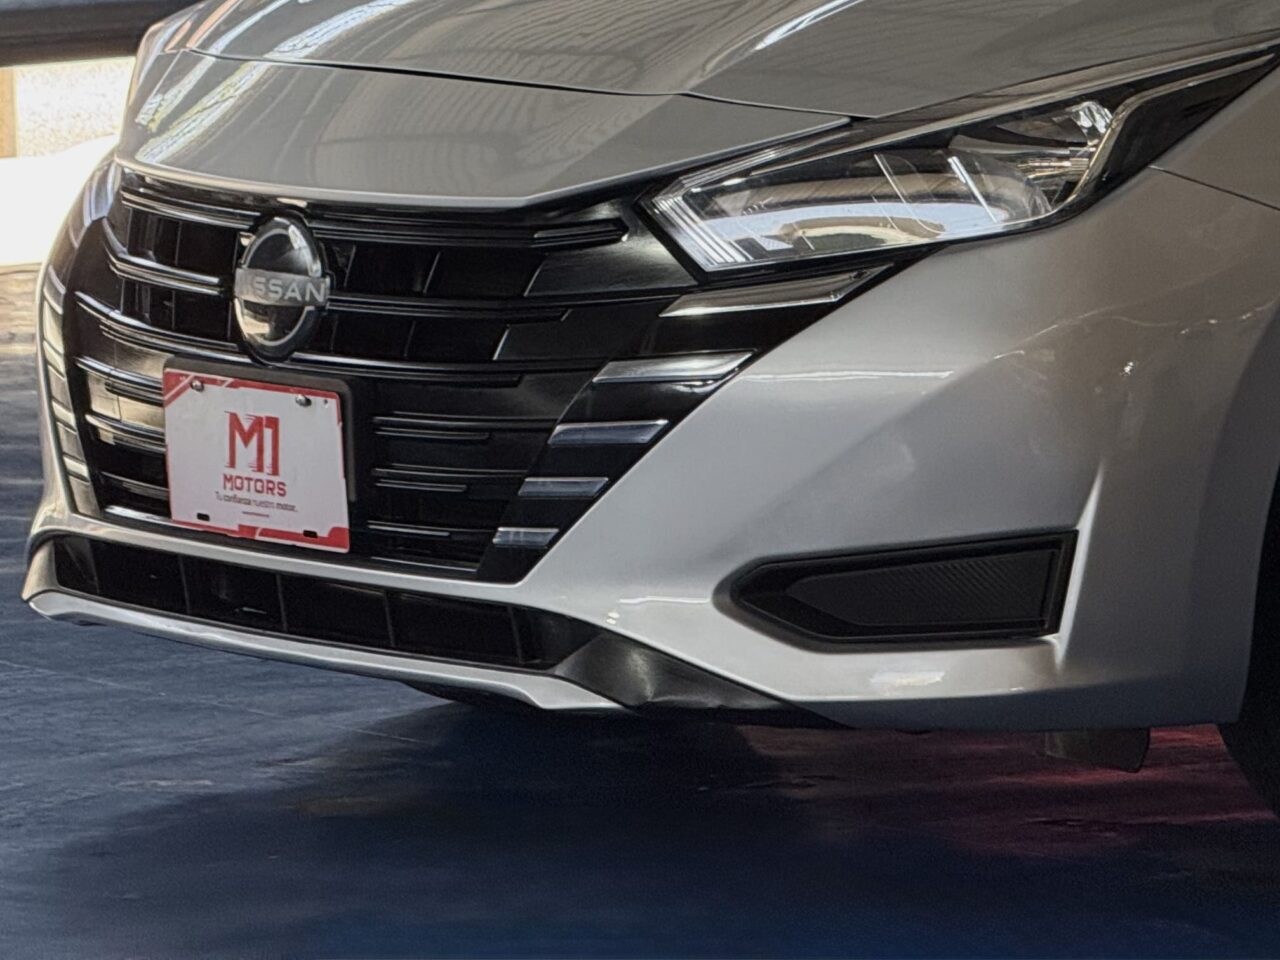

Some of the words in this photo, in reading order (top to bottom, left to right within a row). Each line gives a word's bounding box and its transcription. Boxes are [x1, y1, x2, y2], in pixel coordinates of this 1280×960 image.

[240, 274, 326, 302] SSAN
[224, 410, 280, 477] M1
[222, 473, 287, 497] MOTORS
